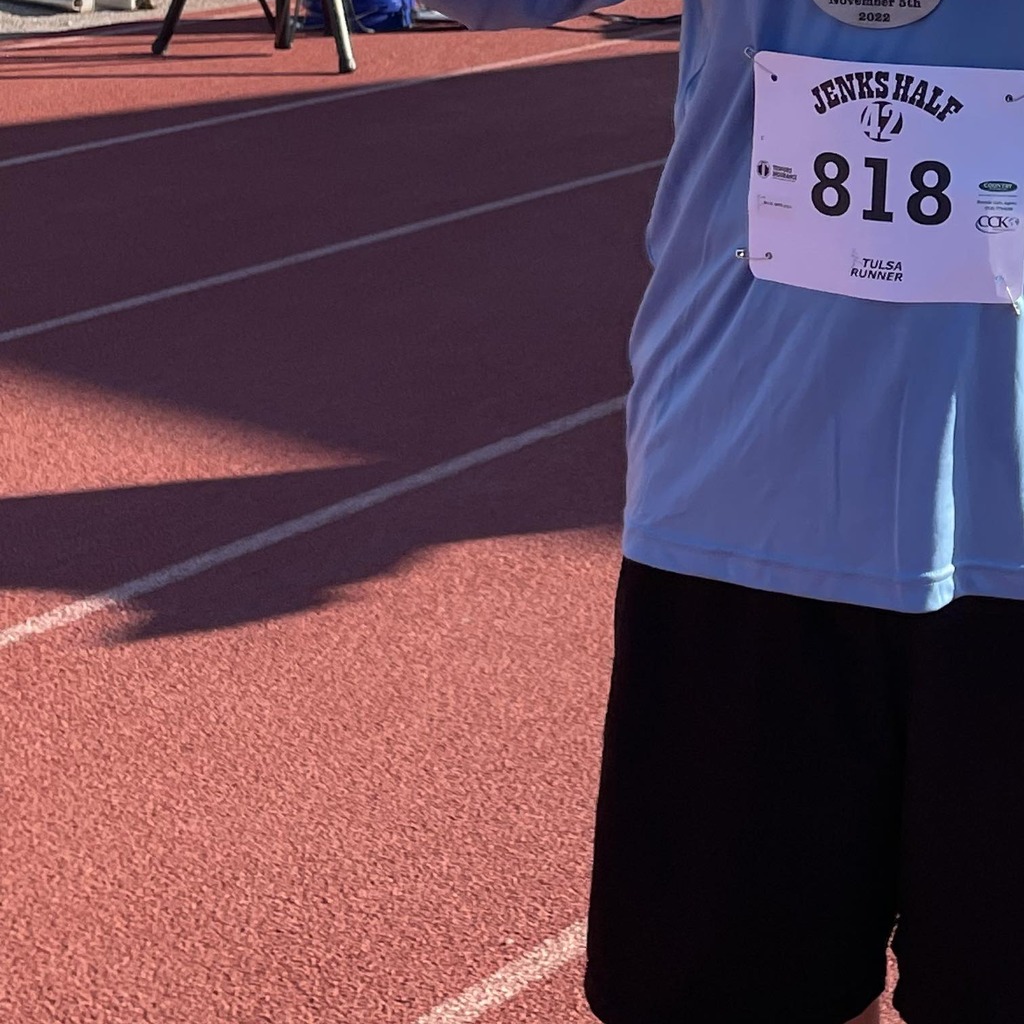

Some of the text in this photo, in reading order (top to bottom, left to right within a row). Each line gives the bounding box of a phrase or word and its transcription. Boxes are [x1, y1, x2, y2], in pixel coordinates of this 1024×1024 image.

[858, 12, 891, 23] 2022
[811, 71, 964, 123] JENKS HALF
[860, 100, 904, 143] 42
[811, 151, 952, 226] 818
[978, 215, 1009, 228] CCK
[862, 257, 903, 272] TULSA
[850, 267, 904, 282] RUNNER
